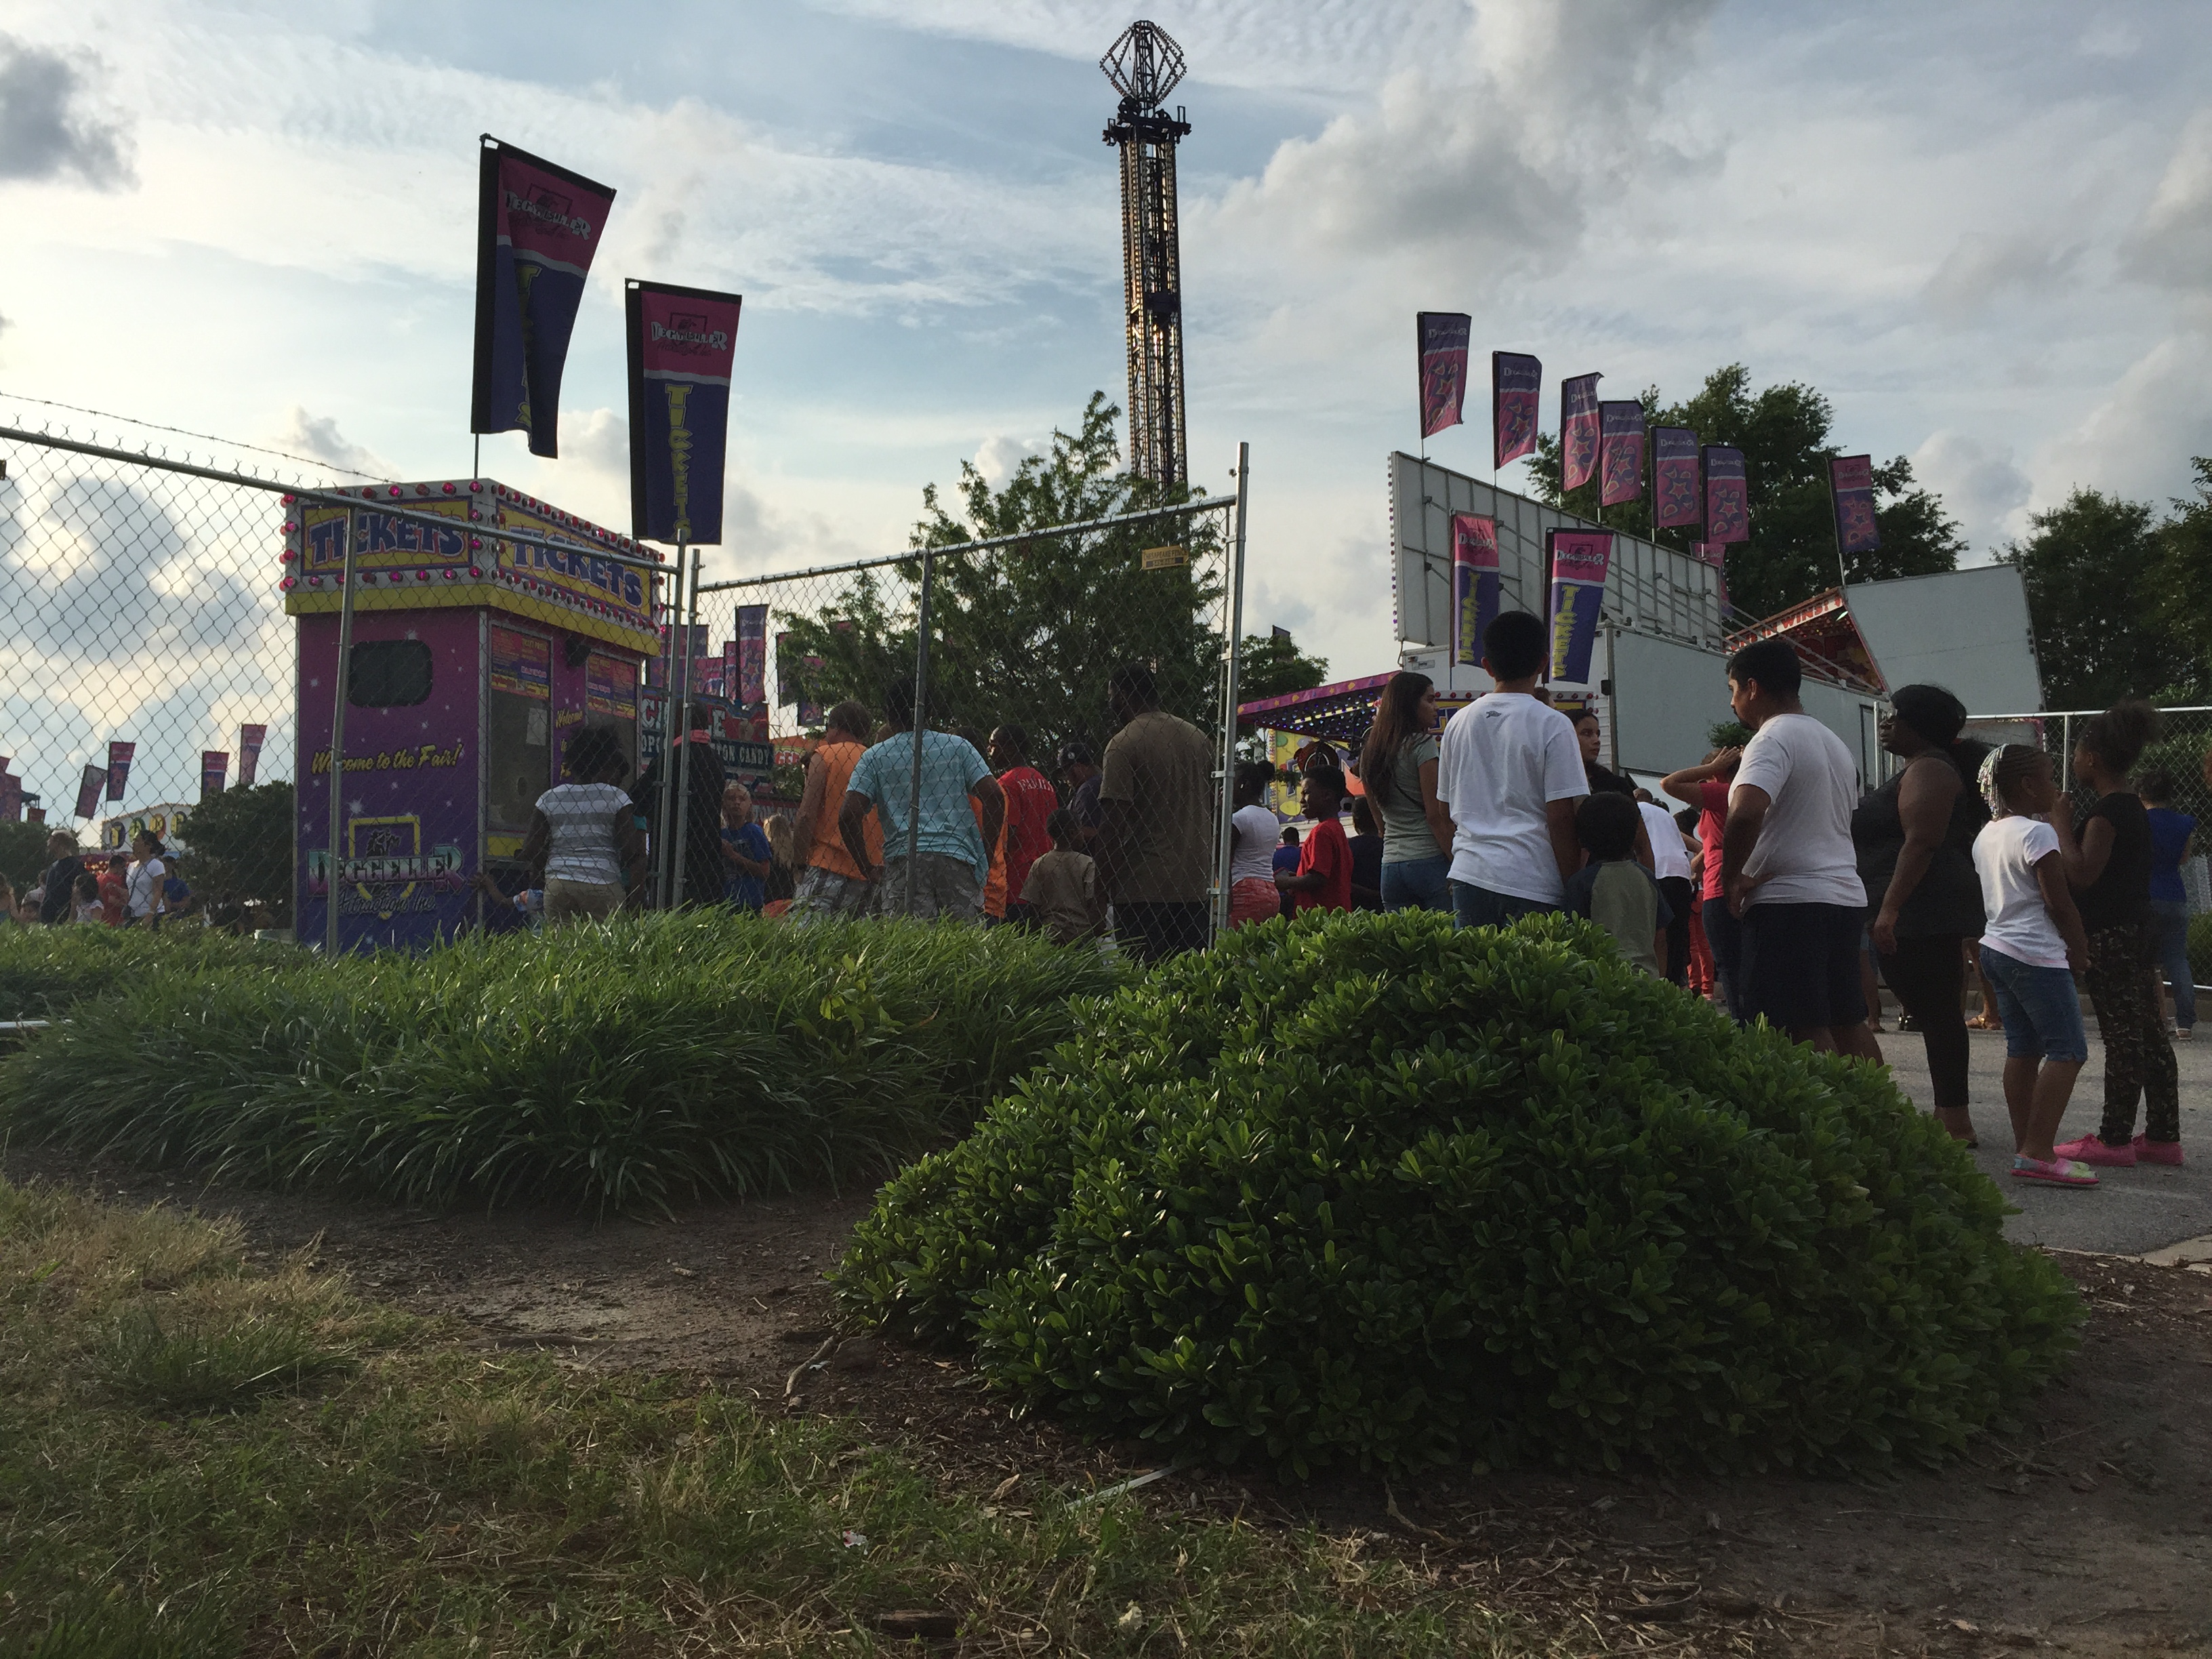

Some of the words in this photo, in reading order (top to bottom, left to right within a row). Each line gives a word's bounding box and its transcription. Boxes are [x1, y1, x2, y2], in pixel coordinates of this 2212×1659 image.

[665, 384, 693, 541] TICKETS
[309, 512, 465, 565] TICKETS
[508, 525, 644, 609] TICKETS
[1458, 573, 1481, 662] TICKETS
[1552, 585, 1581, 678] TICKETS
[311, 748, 373, 775] Weome
[376, 752, 392, 770] to
[392, 748, 415, 769] the
[417, 744, 464, 769] Fair!
[739, 745, 770, 765] CANDY
